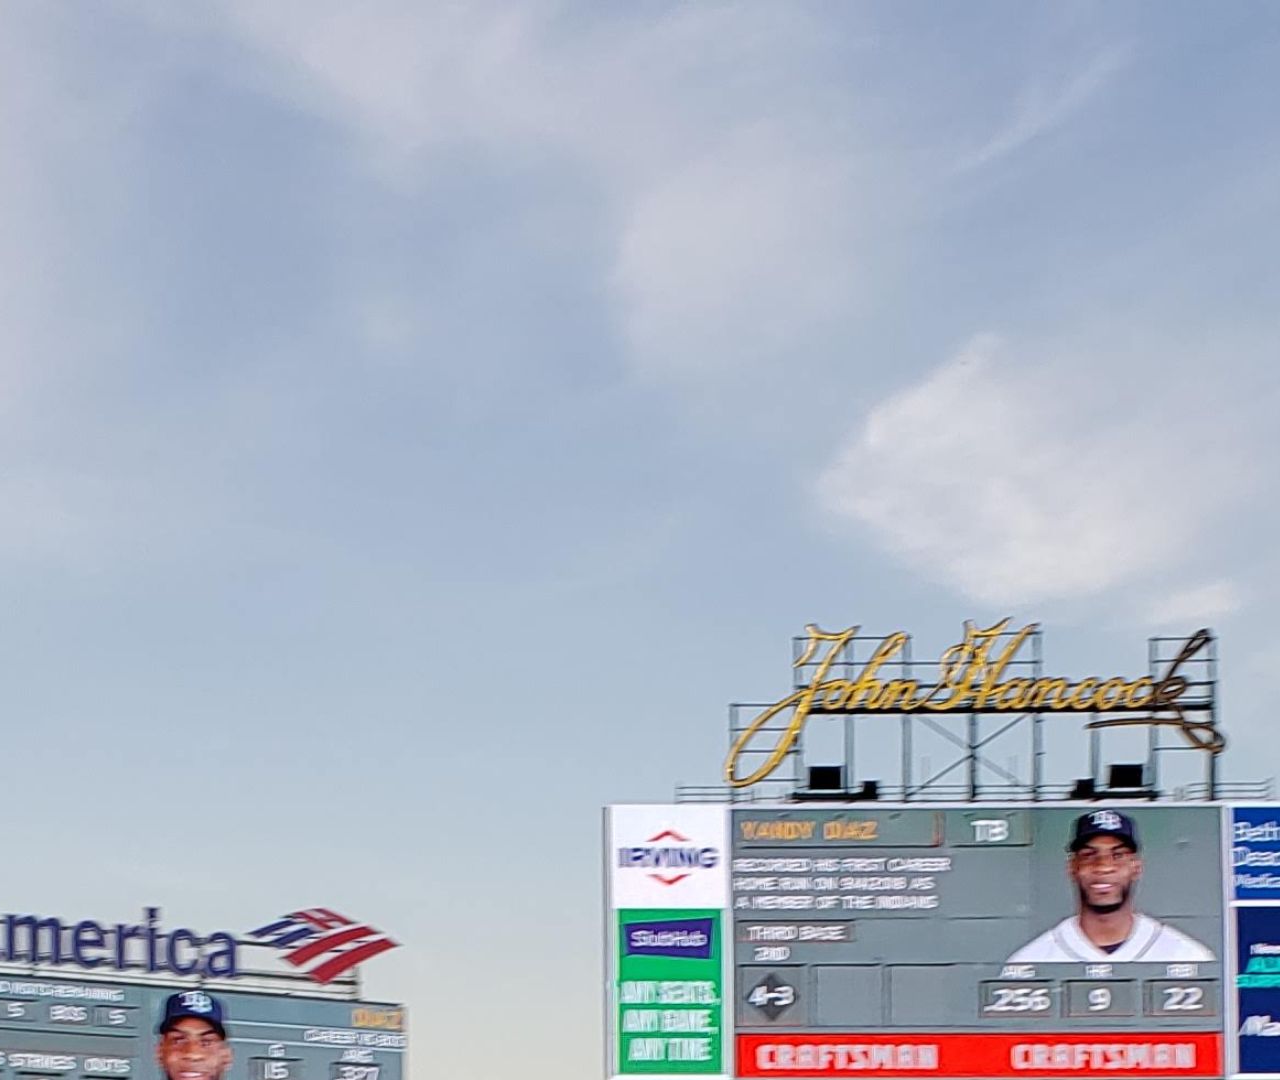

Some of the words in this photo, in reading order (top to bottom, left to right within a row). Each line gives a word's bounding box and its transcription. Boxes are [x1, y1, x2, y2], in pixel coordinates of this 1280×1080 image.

[725, 623, 917, 788] John
[920, 617, 1224, 753] Hancock
[740, 819, 816, 840] YANDY
[823, 820, 879, 841] DIAZ
[970, 819, 1010, 842] TB
[617, 847, 720, 868] IRVING
[907, 877, 936, 891] AS
[841, 896, 875, 910] THE
[746, 925, 798, 941] THIRD
[799, 925, 848, 941] BASE
[747, 985, 796, 1006] 4-3
[1088, 988, 1111, 1011] 9
[1163, 987, 1204, 1011] 22
[7, 1001, 25, 1018] 5
[109, 1009, 127, 1025] 5
[8, 1053, 77, 1070] STRIKES
[84, 1057, 131, 1073] OUTS
[755, 1043, 940, 1070] CRAFTSMAN
[1010, 1043, 1197, 1070] CRAFTSMAN
[264, 1061, 289, 1080] 15
